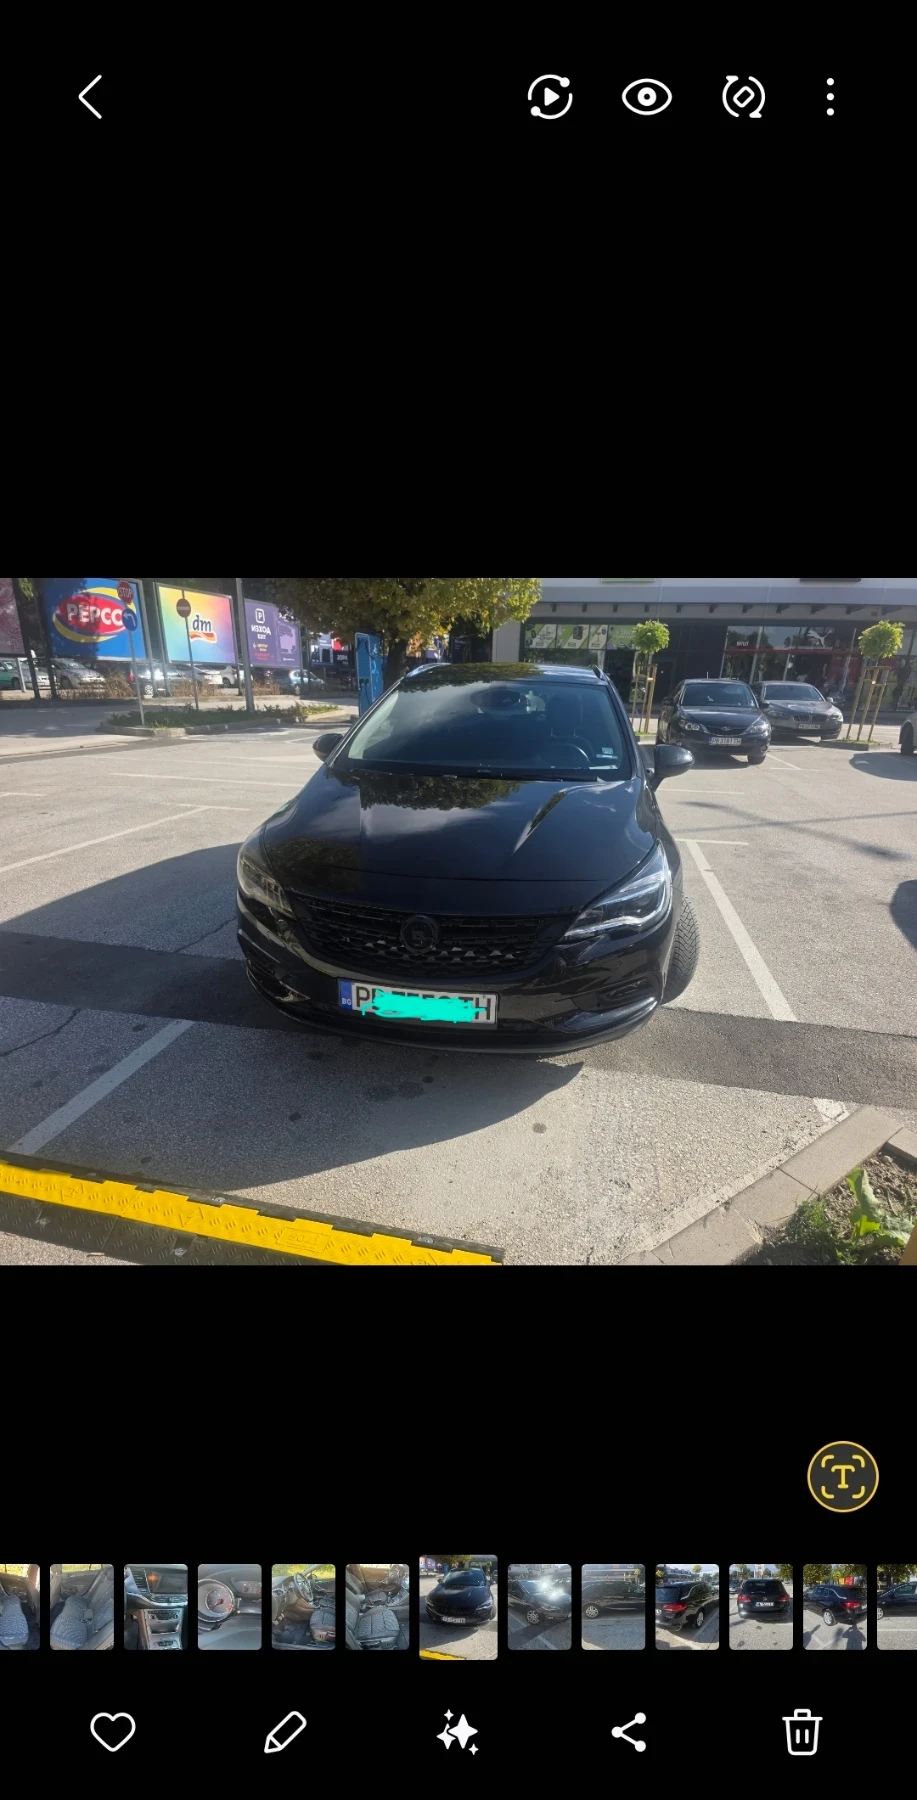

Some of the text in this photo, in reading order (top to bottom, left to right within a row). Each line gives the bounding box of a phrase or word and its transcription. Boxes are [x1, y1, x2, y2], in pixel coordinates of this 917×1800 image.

[119, 586, 132, 599] STOP
[66, 603, 124, 627] PEPCO
[192, 614, 212, 632] dm
[251, 624, 272, 635] ИЗХОД
[341, 997, 352, 1006] BG
